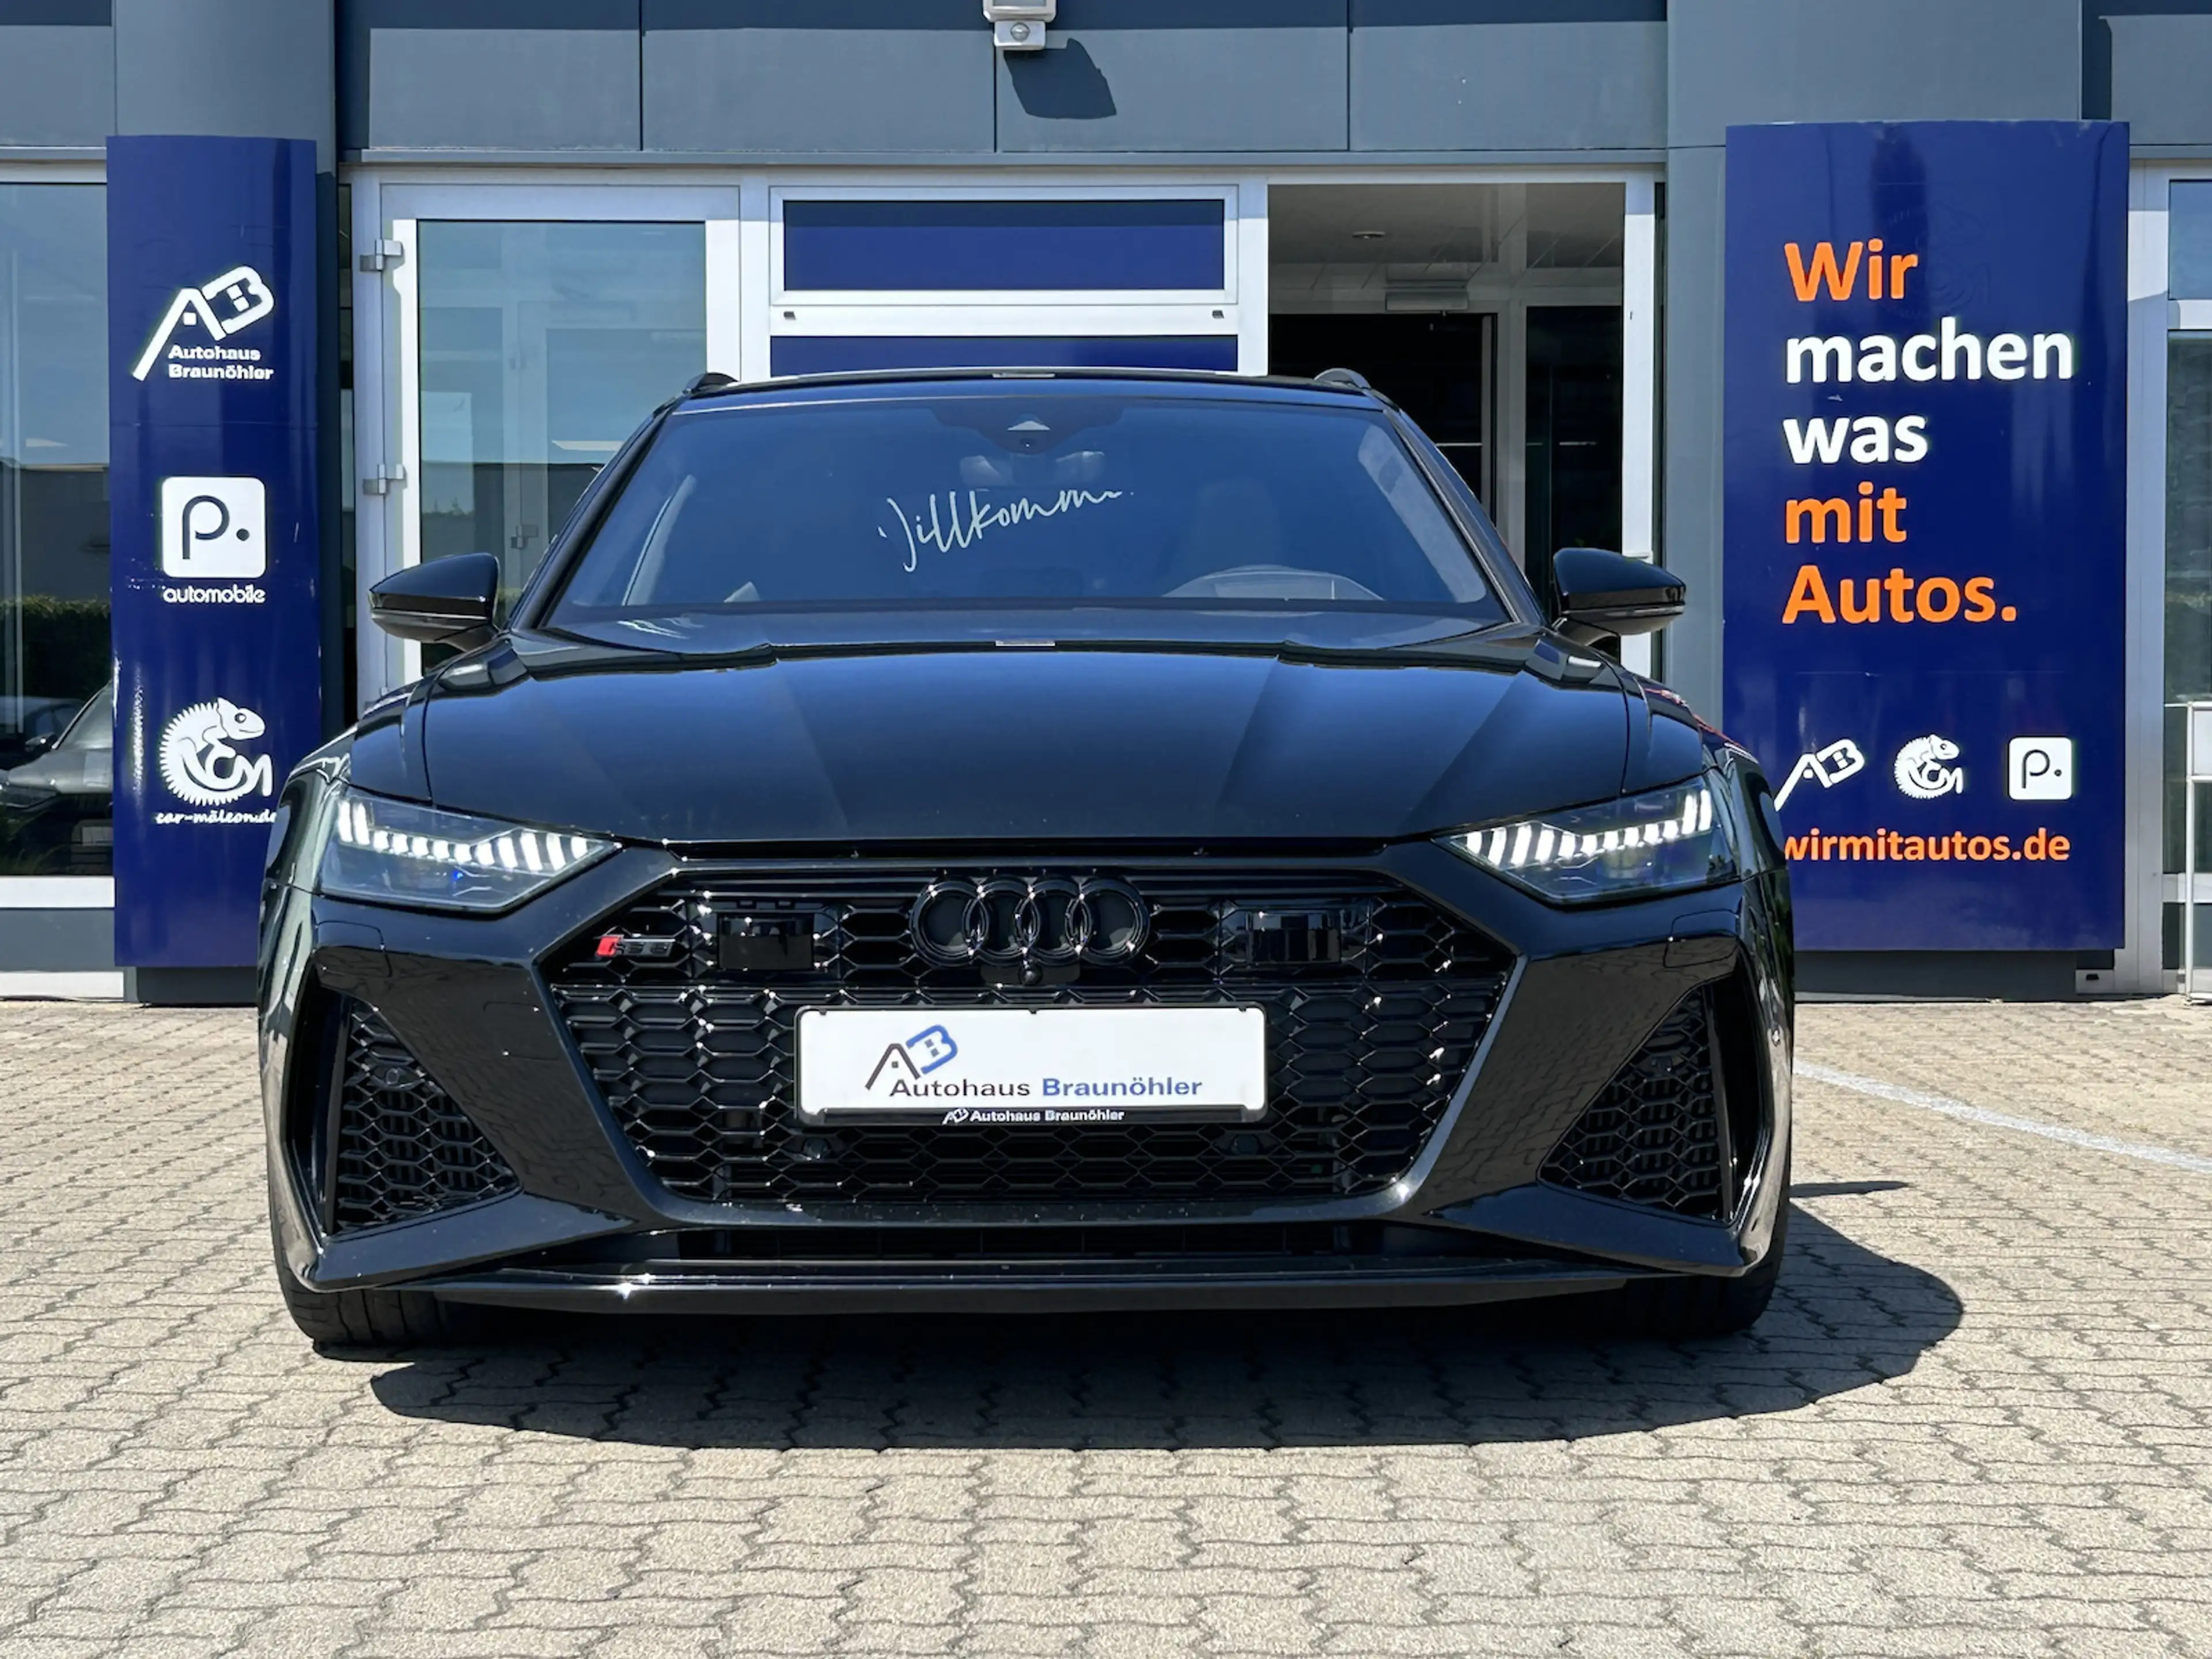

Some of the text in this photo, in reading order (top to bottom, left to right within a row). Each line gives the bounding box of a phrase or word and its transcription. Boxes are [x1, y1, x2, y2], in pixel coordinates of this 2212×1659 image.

[1784, 238, 1918, 301] Wir
[168, 344, 261, 361] Autohaus
[1787, 316, 2073, 384] machen
[168, 363, 274, 380] Braunöhler
[1783, 414, 1928, 464] was
[1785, 481, 1907, 543] mit
[162, 584, 266, 604] automobile
[1782, 565, 2017, 624] Autos.
[1784, 827, 2070, 861] wirmitautos.de
[889, 1077, 1203, 1097] Autohaus Braunöhler
[969, 1110, 1040, 1122] Autohaus
[1044, 1108, 1125, 1122] Braunöhler
